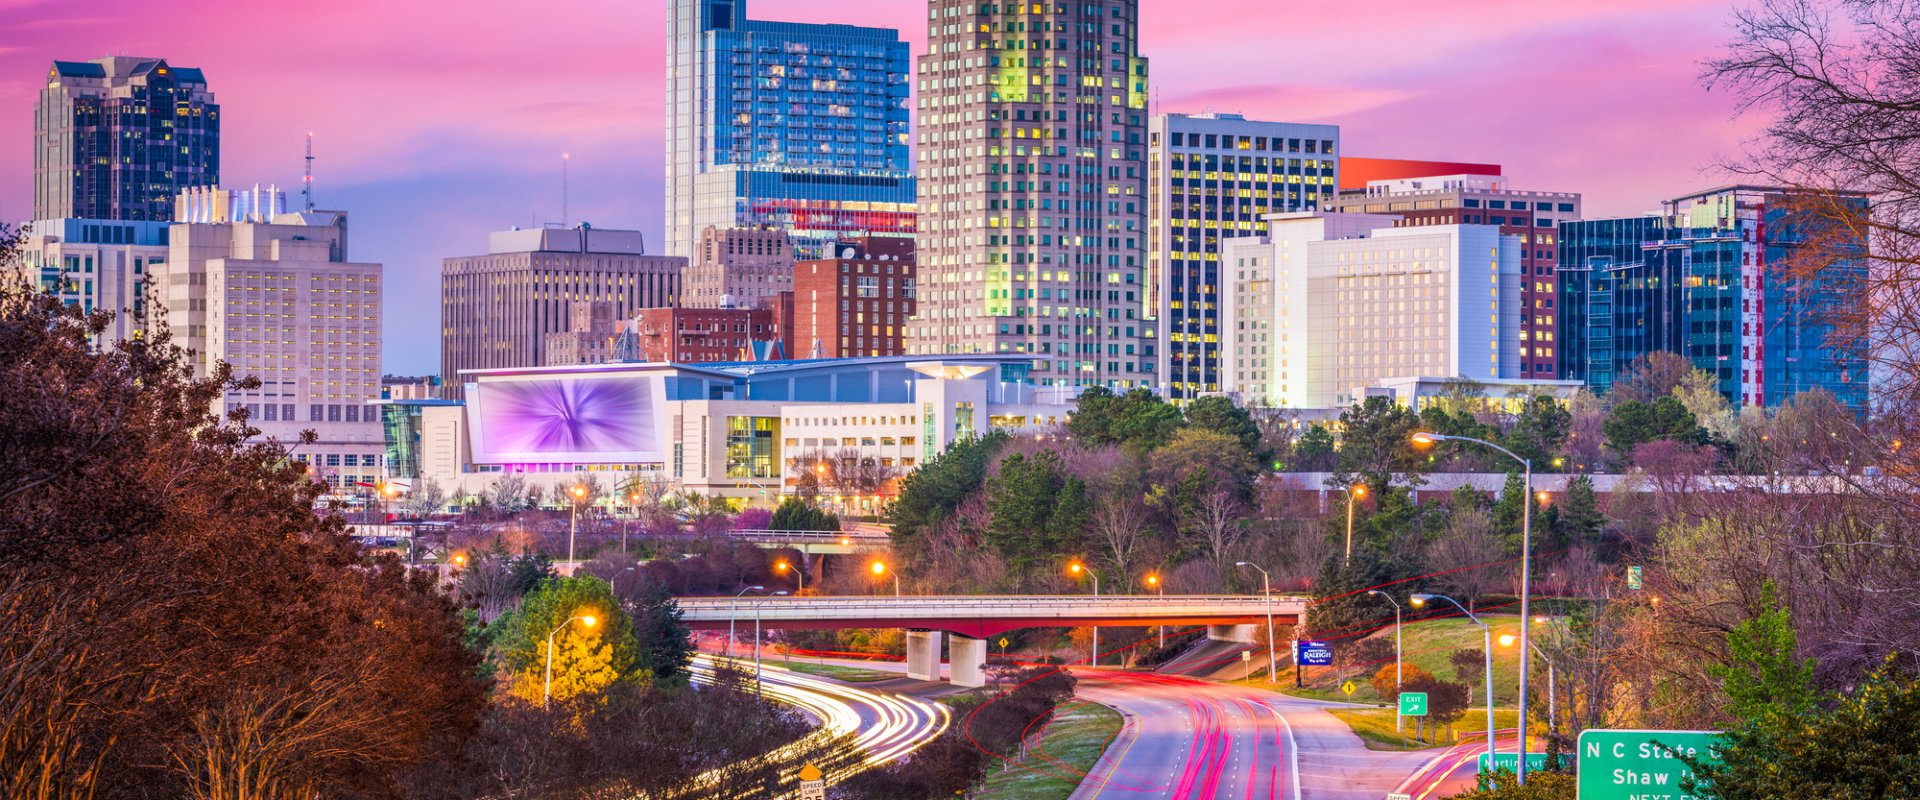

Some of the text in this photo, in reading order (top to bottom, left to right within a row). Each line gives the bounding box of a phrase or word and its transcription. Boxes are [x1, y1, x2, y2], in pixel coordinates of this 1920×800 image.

[1587, 742, 1600, 758] N
[1613, 743, 1625, 758] C
[1639, 743, 1697, 759] State
[1613, 769, 1669, 785] Shaw
